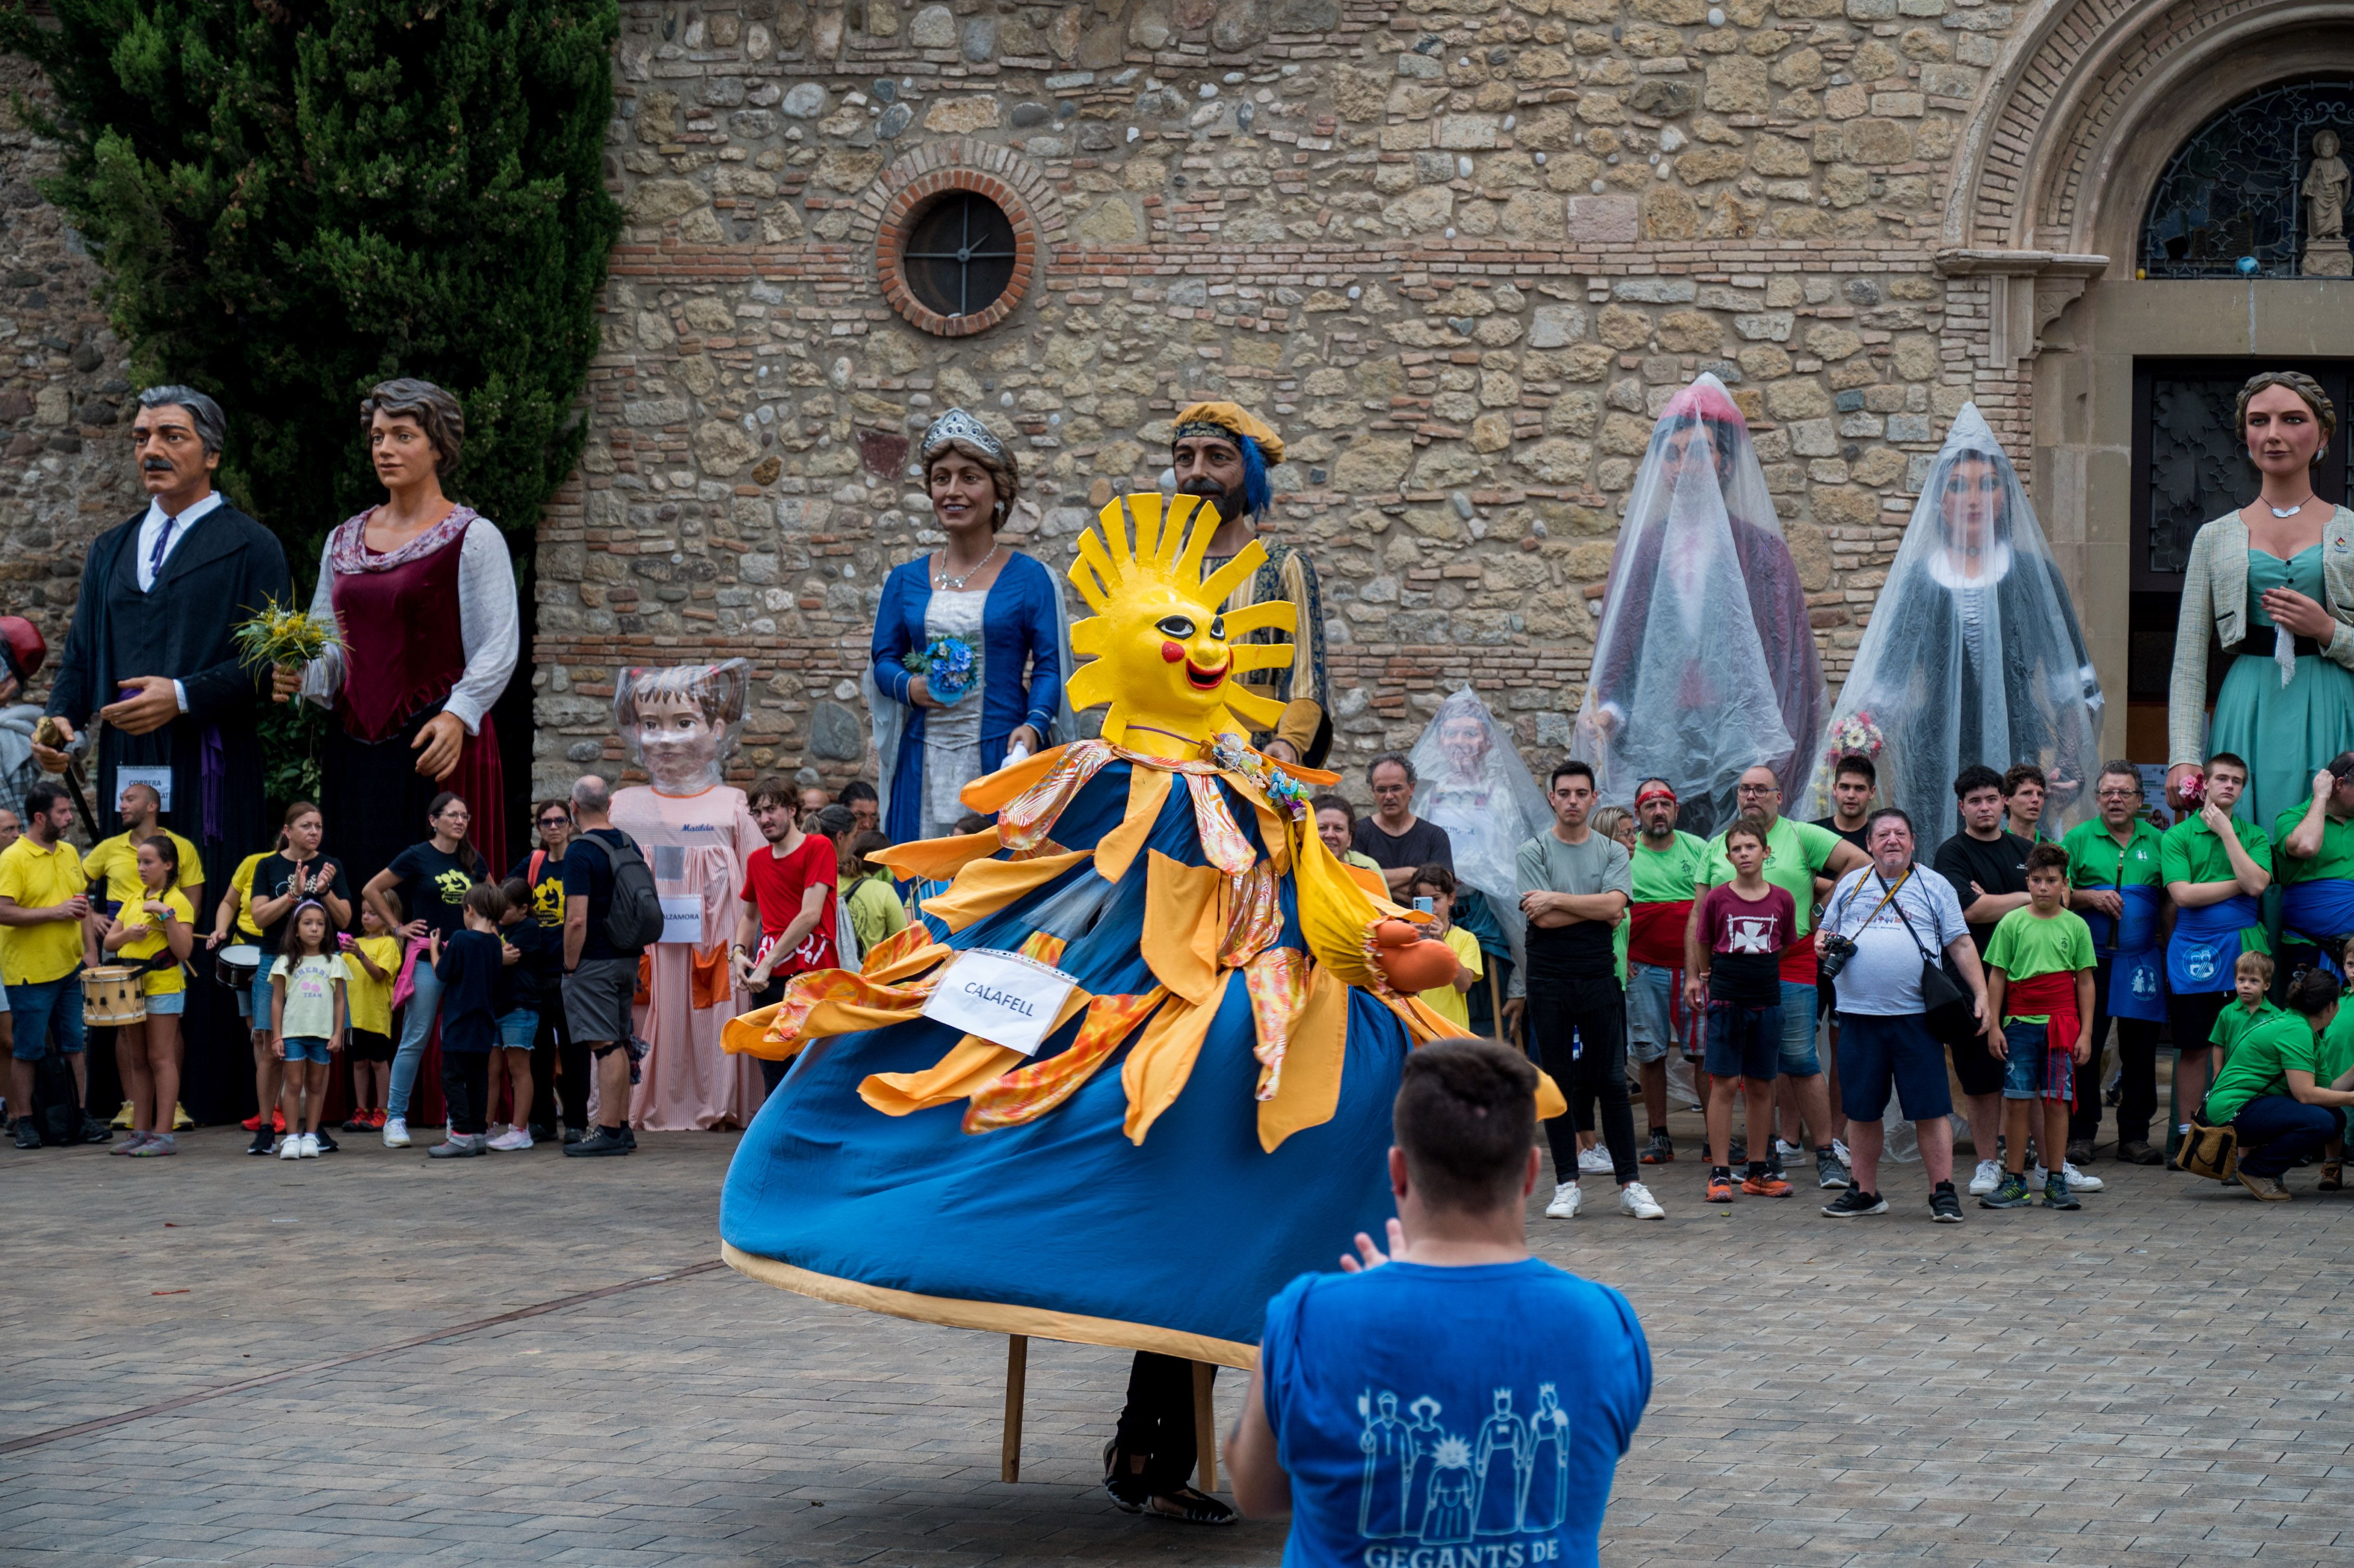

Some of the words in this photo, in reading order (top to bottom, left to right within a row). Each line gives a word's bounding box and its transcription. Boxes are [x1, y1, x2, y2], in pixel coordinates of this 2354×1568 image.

[682, 824, 715, 832] Matilda
[964, 982, 1034, 1017] CALAFELL
[1364, 1541, 1528, 1568] GEGANTS
[1532, 1538, 1559, 1563] DE
